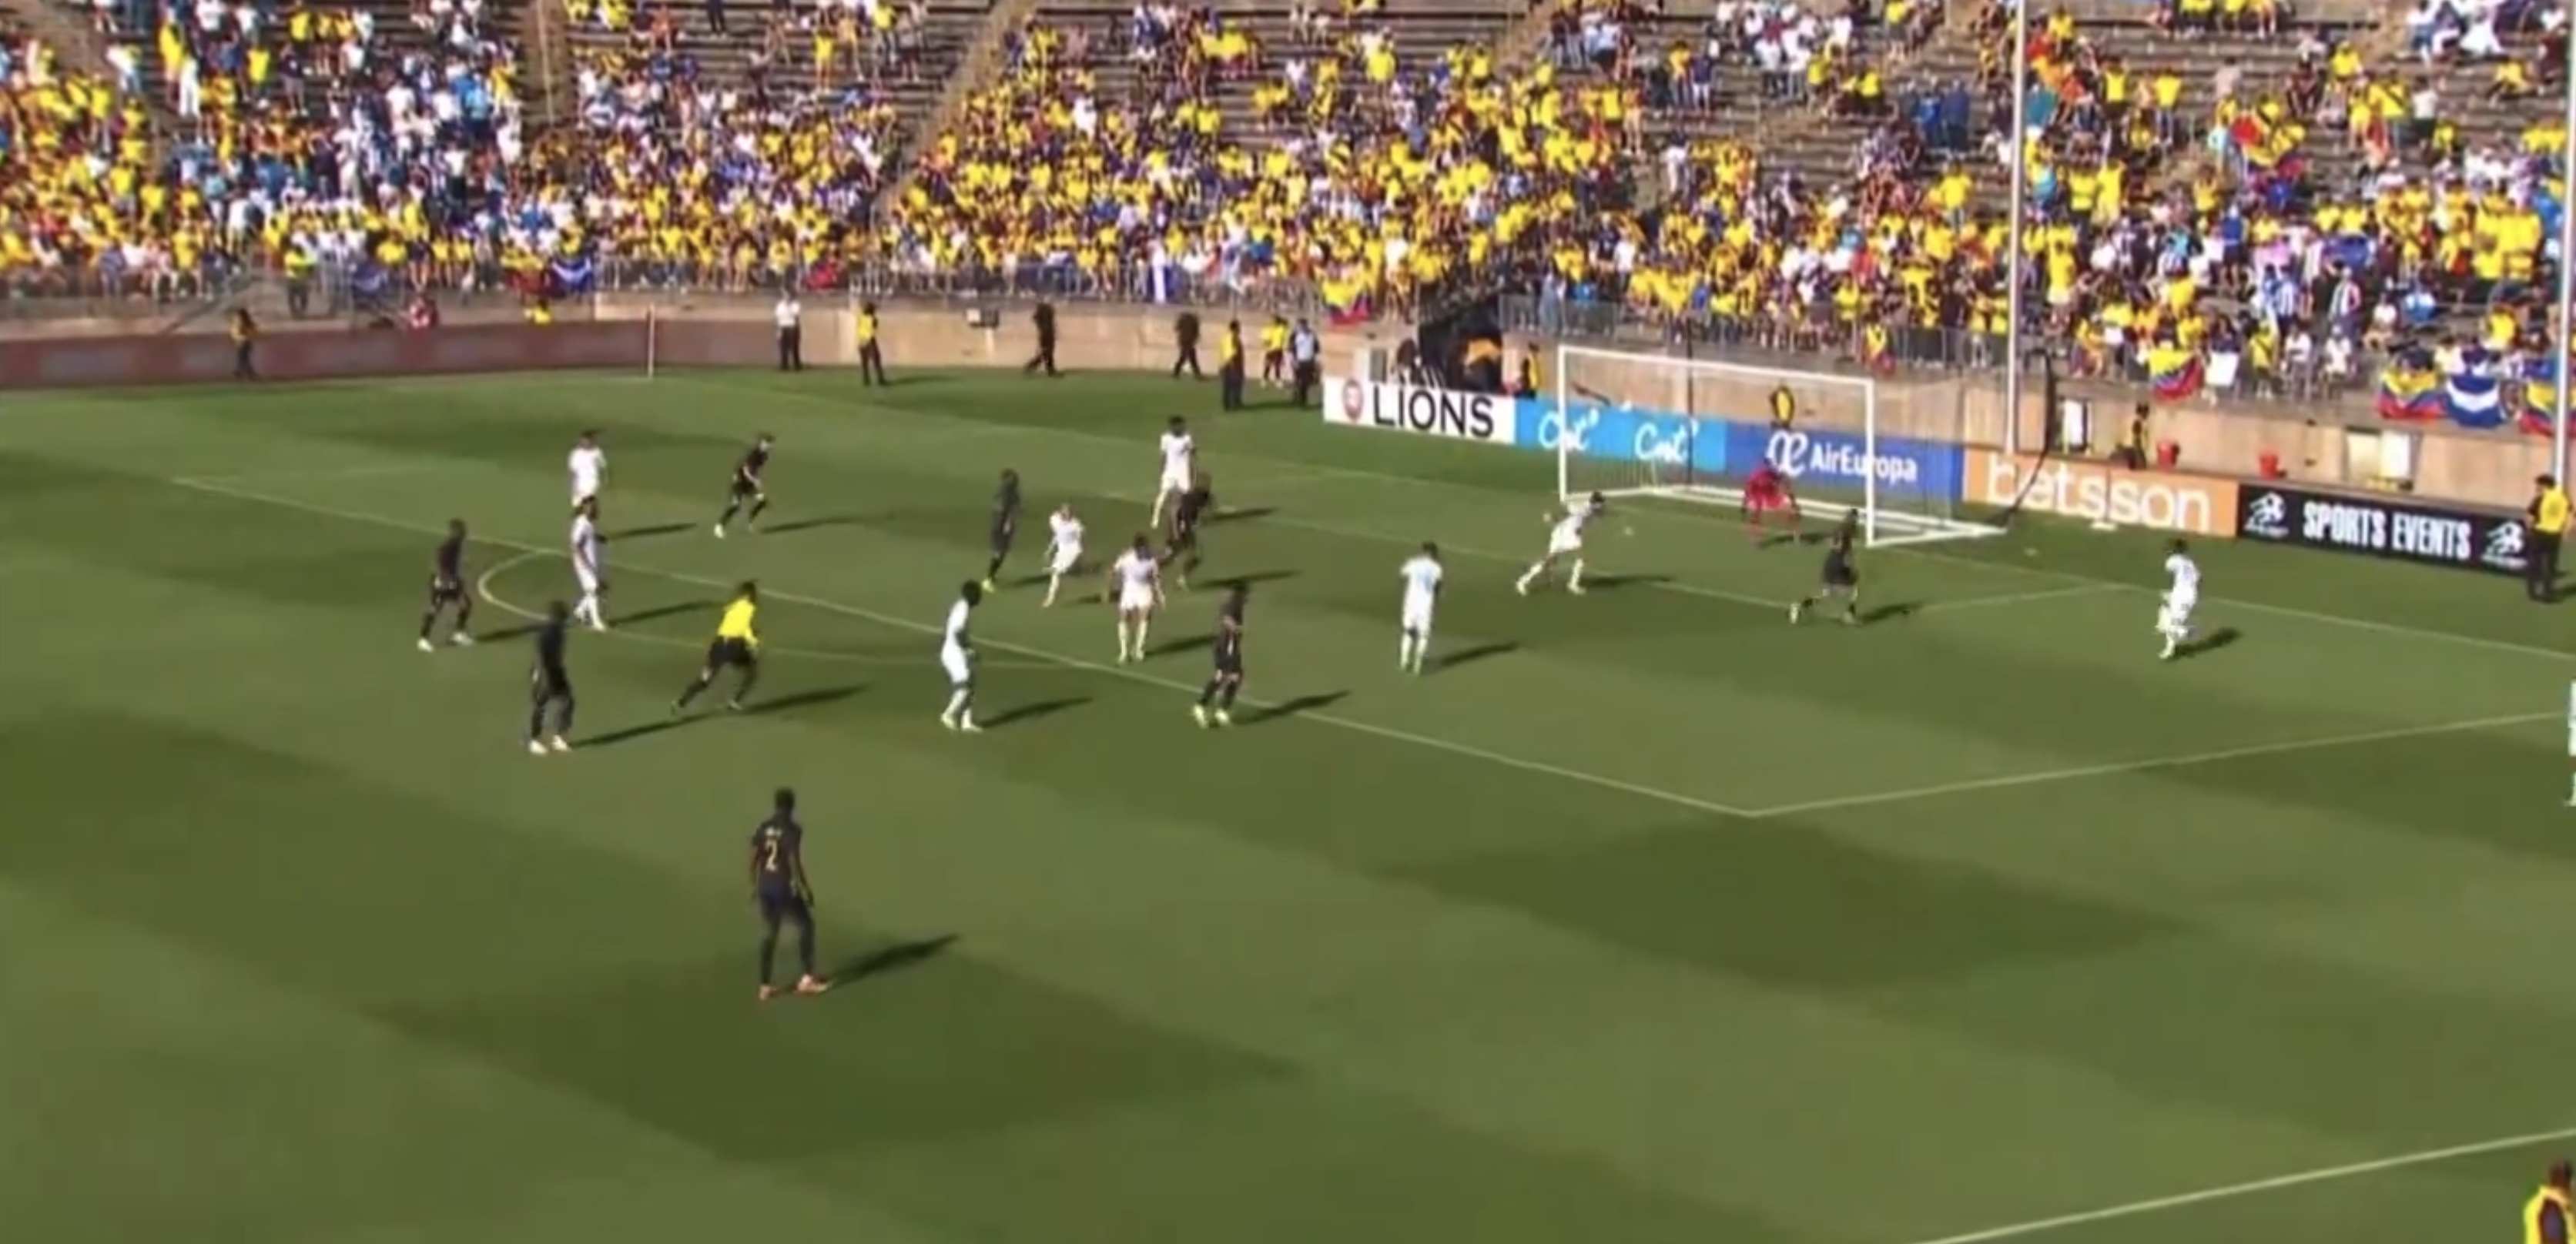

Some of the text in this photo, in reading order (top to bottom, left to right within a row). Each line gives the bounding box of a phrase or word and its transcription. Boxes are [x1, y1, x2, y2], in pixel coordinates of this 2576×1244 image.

[1374, 386, 1494, 439] LIONS
[1811, 443, 1918, 487] AirEuopa
[1986, 450, 2210, 533] betsson
[2303, 501, 2471, 560] SPORTS EVENTS
[765, 839, 778, 871] 2
